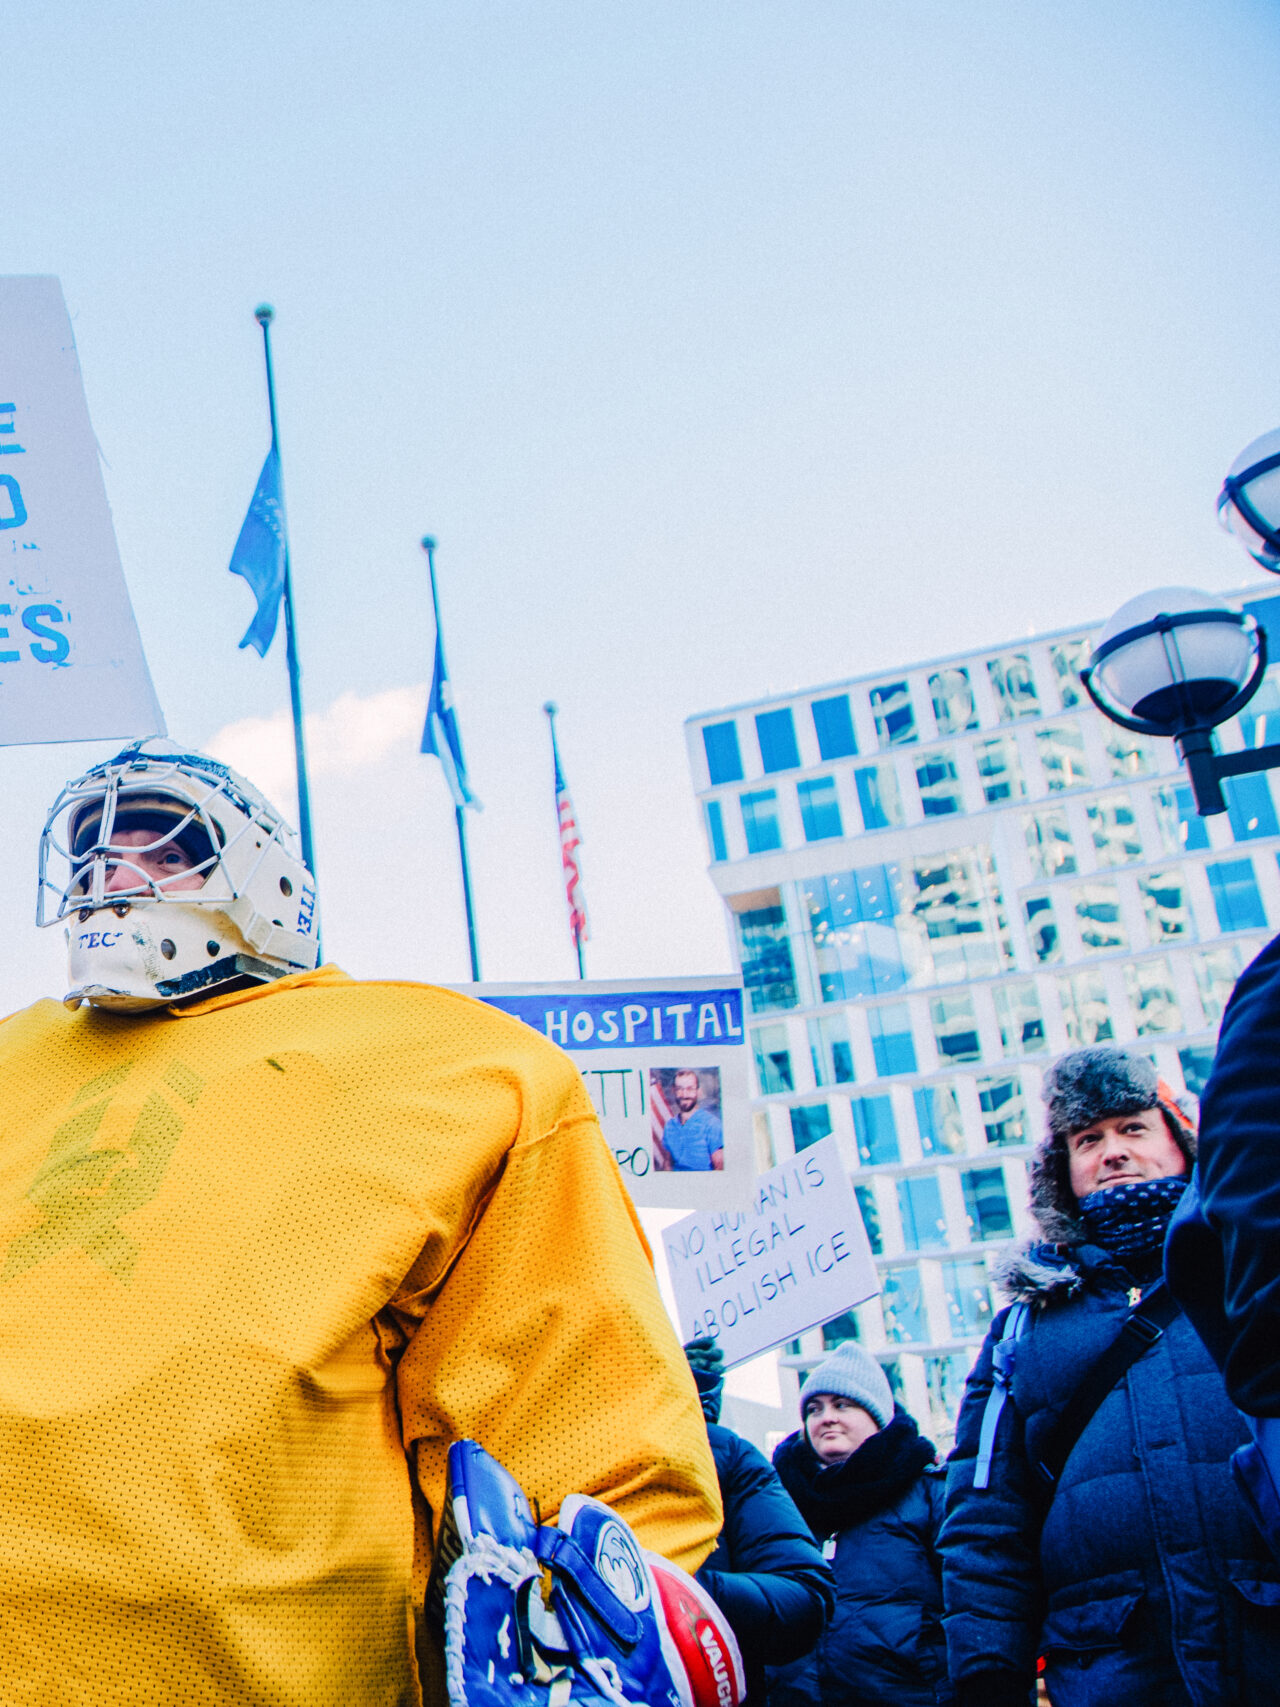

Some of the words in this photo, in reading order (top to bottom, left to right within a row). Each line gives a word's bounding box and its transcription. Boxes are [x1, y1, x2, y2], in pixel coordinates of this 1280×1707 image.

[545, 1002, 742, 1045] HOSPITAL
[581, 1068, 645, 1118] TTI
[669, 1225, 705, 1269] NO
[793, 1156, 825, 1196] IS
[696, 1212, 806, 1293] ILLEGAL
[693, 1260, 798, 1341] ABOLISH
[806, 1230, 851, 1278] ICE
